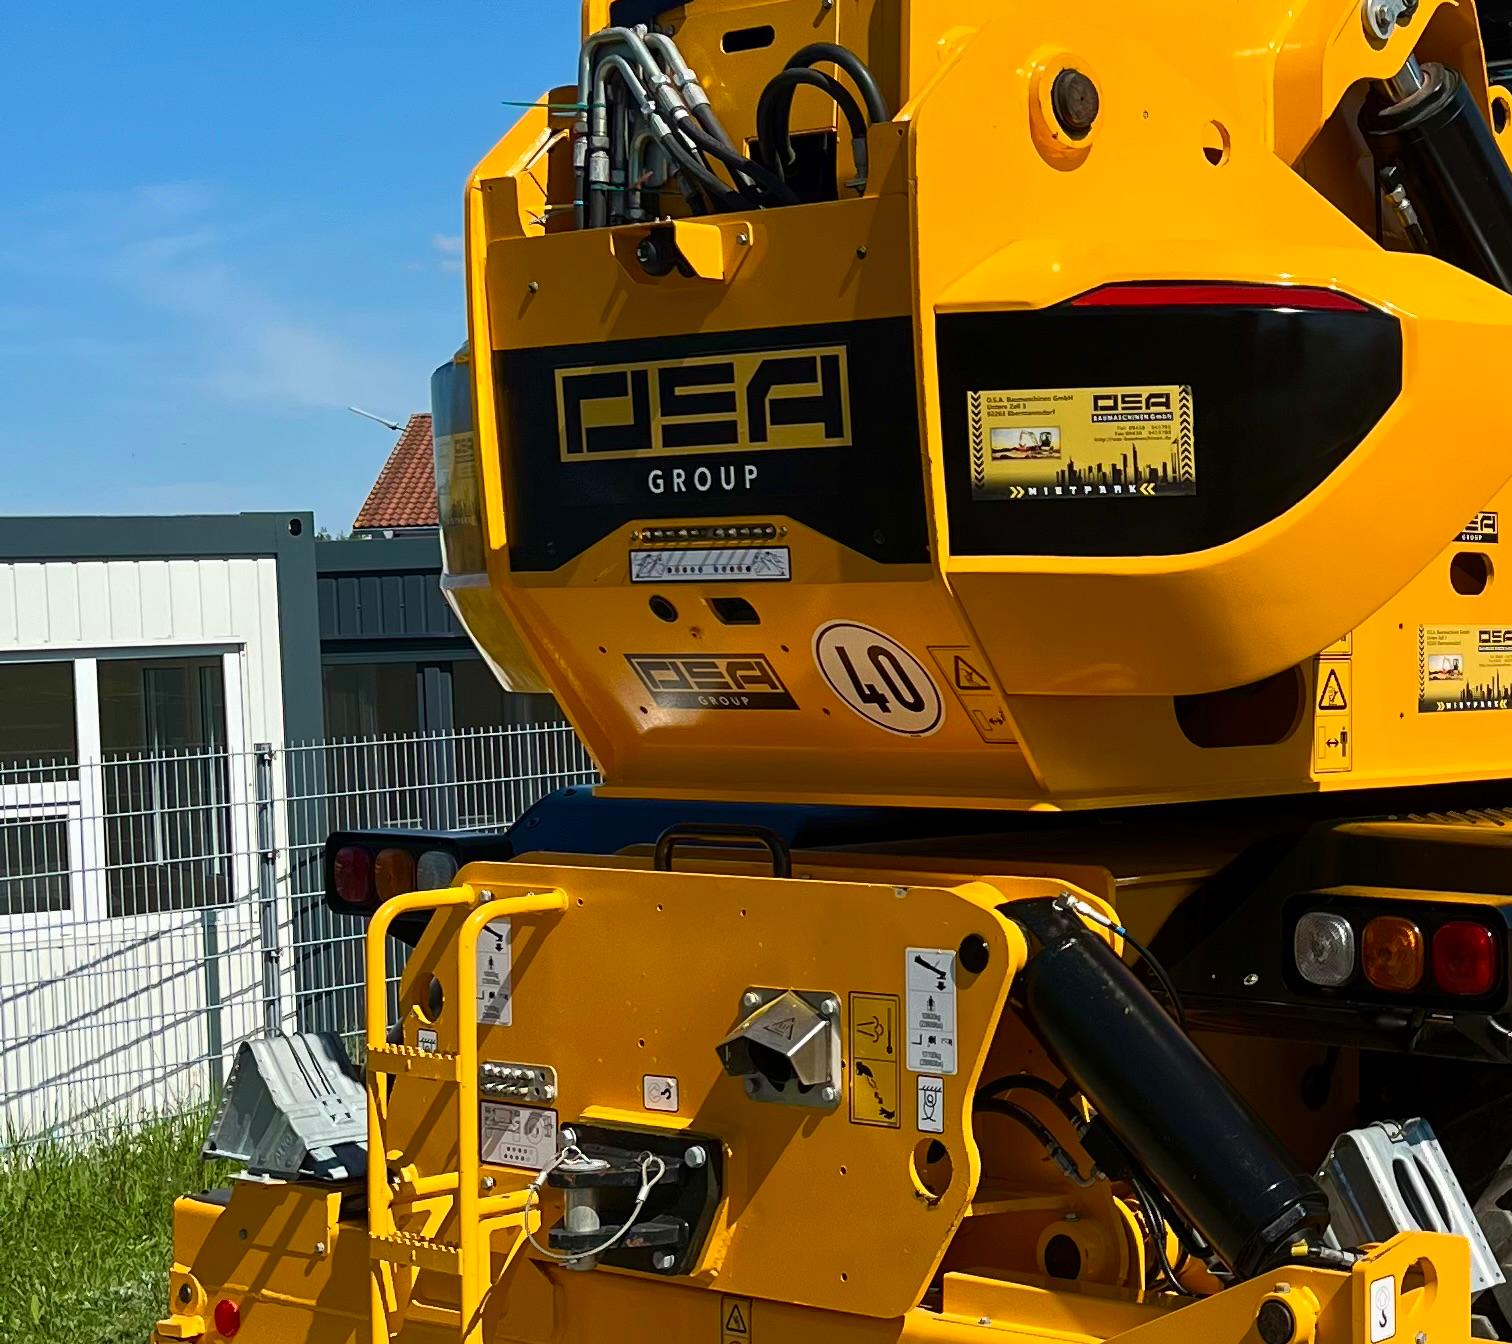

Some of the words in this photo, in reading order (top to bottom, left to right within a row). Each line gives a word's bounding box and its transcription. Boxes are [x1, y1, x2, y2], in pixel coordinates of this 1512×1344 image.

[648, 465, 758, 494] GROUP
[1028, 484, 1137, 496] MIETPARK
[834, 644, 926, 713] 40
[698, 695, 751, 706] GROUP
